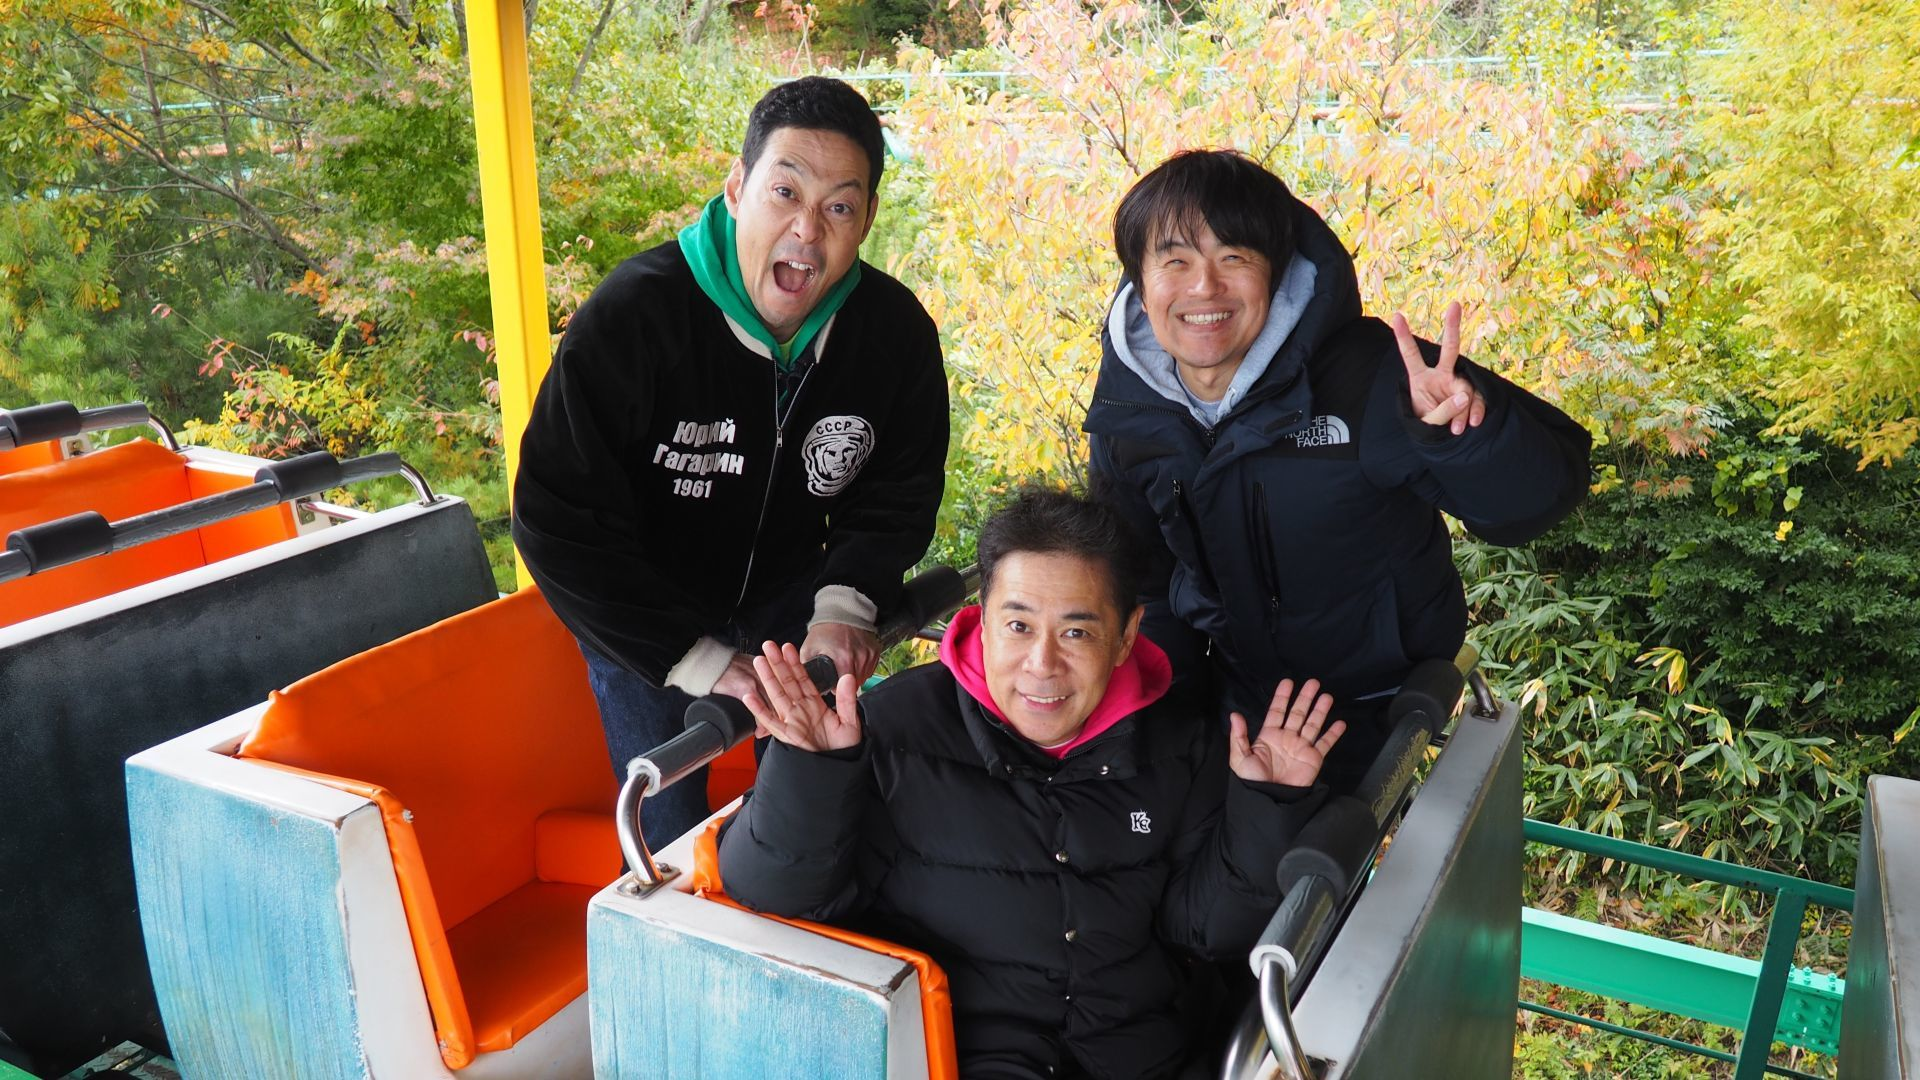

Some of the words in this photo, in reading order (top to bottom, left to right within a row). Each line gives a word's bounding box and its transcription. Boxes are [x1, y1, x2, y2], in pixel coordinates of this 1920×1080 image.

[673, 418, 736, 447] Юрий
[816, 421, 852, 434] СССР
[1297, 436, 1328, 448] FACE
[653, 443, 745, 475] Гагарин
[673, 478, 713, 498] 1961
